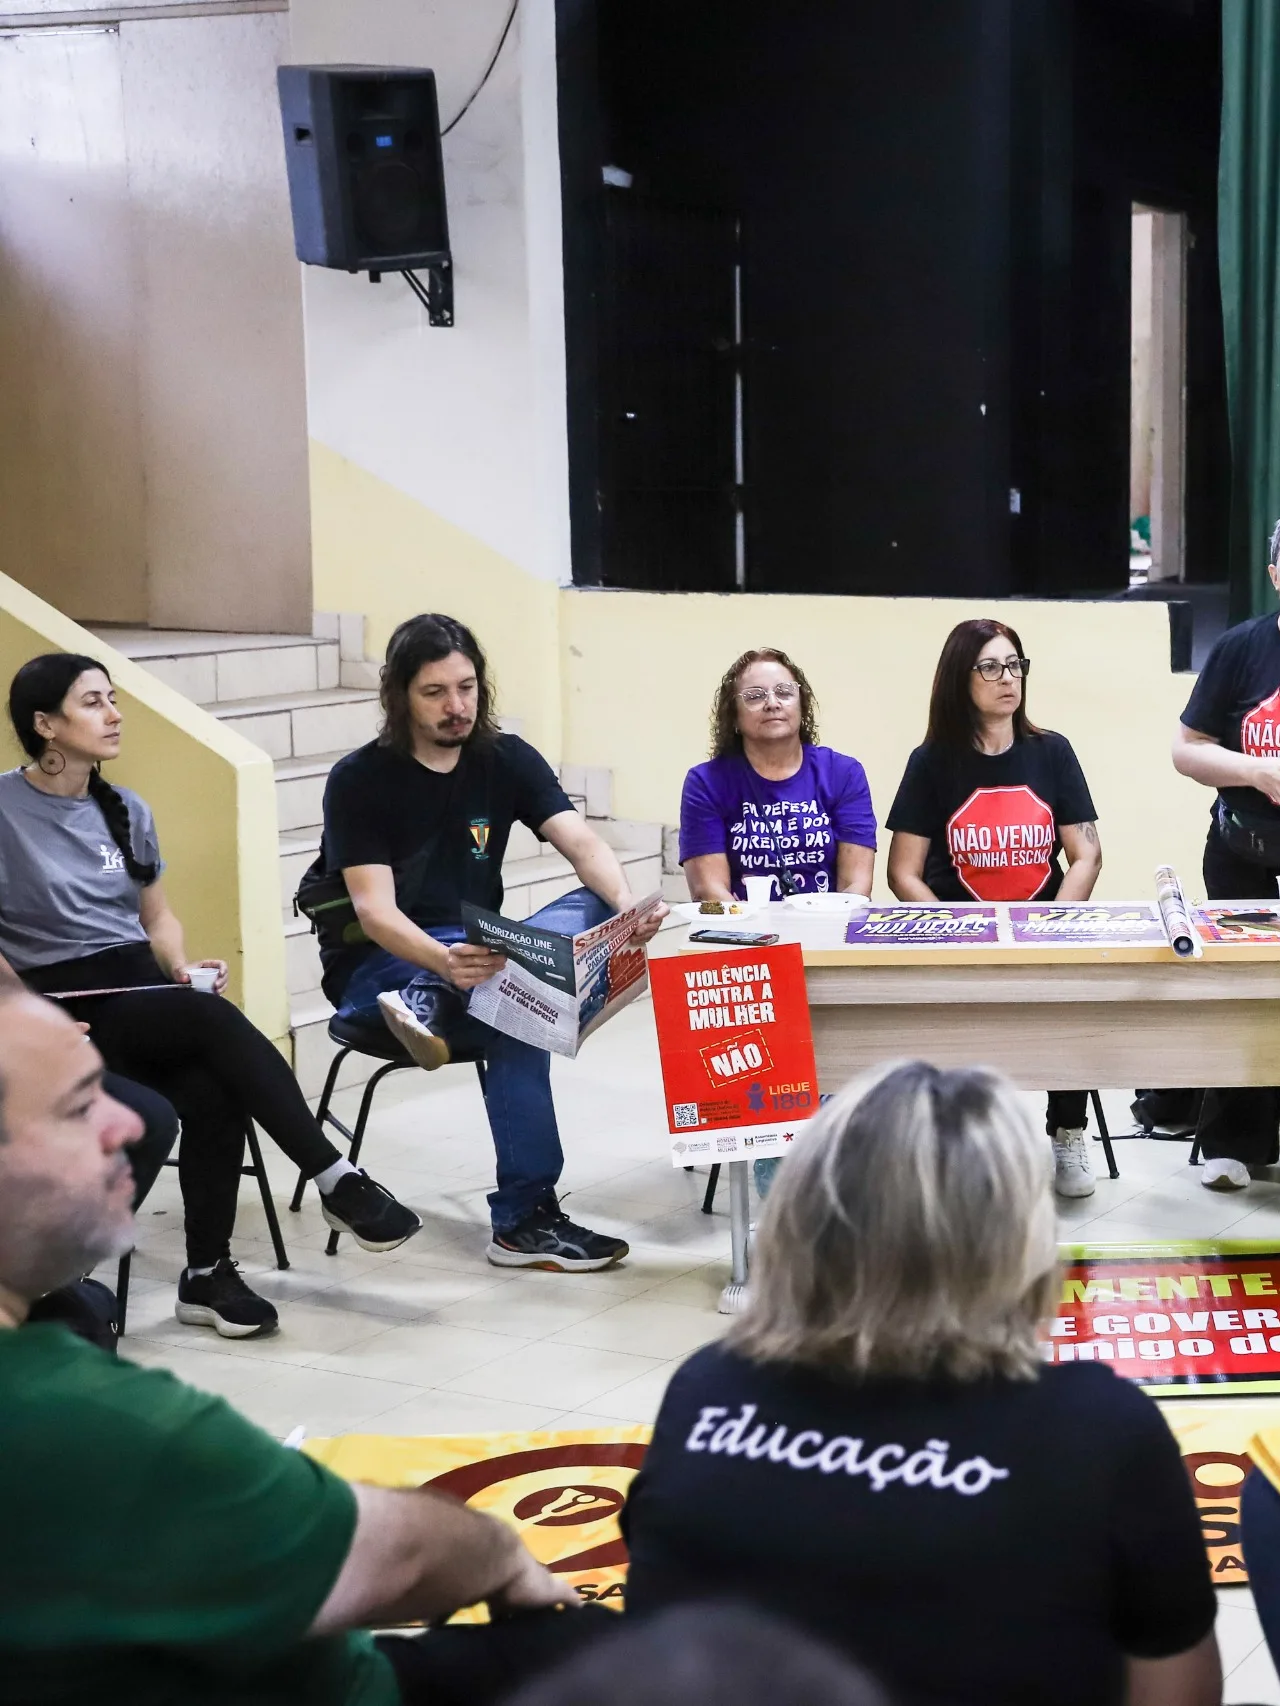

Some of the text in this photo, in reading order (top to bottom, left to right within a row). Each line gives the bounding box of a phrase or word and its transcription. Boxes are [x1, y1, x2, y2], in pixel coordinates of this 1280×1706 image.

[762, 800, 818, 817] DEFESA
[788, 817, 798, 831] E
[803, 812, 830, 829] DOS
[732, 830, 831, 852] DIREITOS DAS
[953, 823, 1052, 852] NÃO VENDA
[740, 850, 825, 869] MULHERES
[968, 851, 1009, 868] MINHA
[478, 919, 532, 945] VALORIZAÇÃO
[855, 920, 989, 934] MULHERES
[684, 963, 772, 989] VIOLÊNCIA
[686, 982, 774, 1008] CONTRA A
[530, 1005, 556, 1025] EMPRESA
[688, 1002, 776, 1031] MULHER
[710, 1042, 764, 1078] NÃO
[769, 1081, 811, 1096] LIGUE
[771, 1092, 812, 1111] 180
[685, 1403, 1010, 1496] Educação
